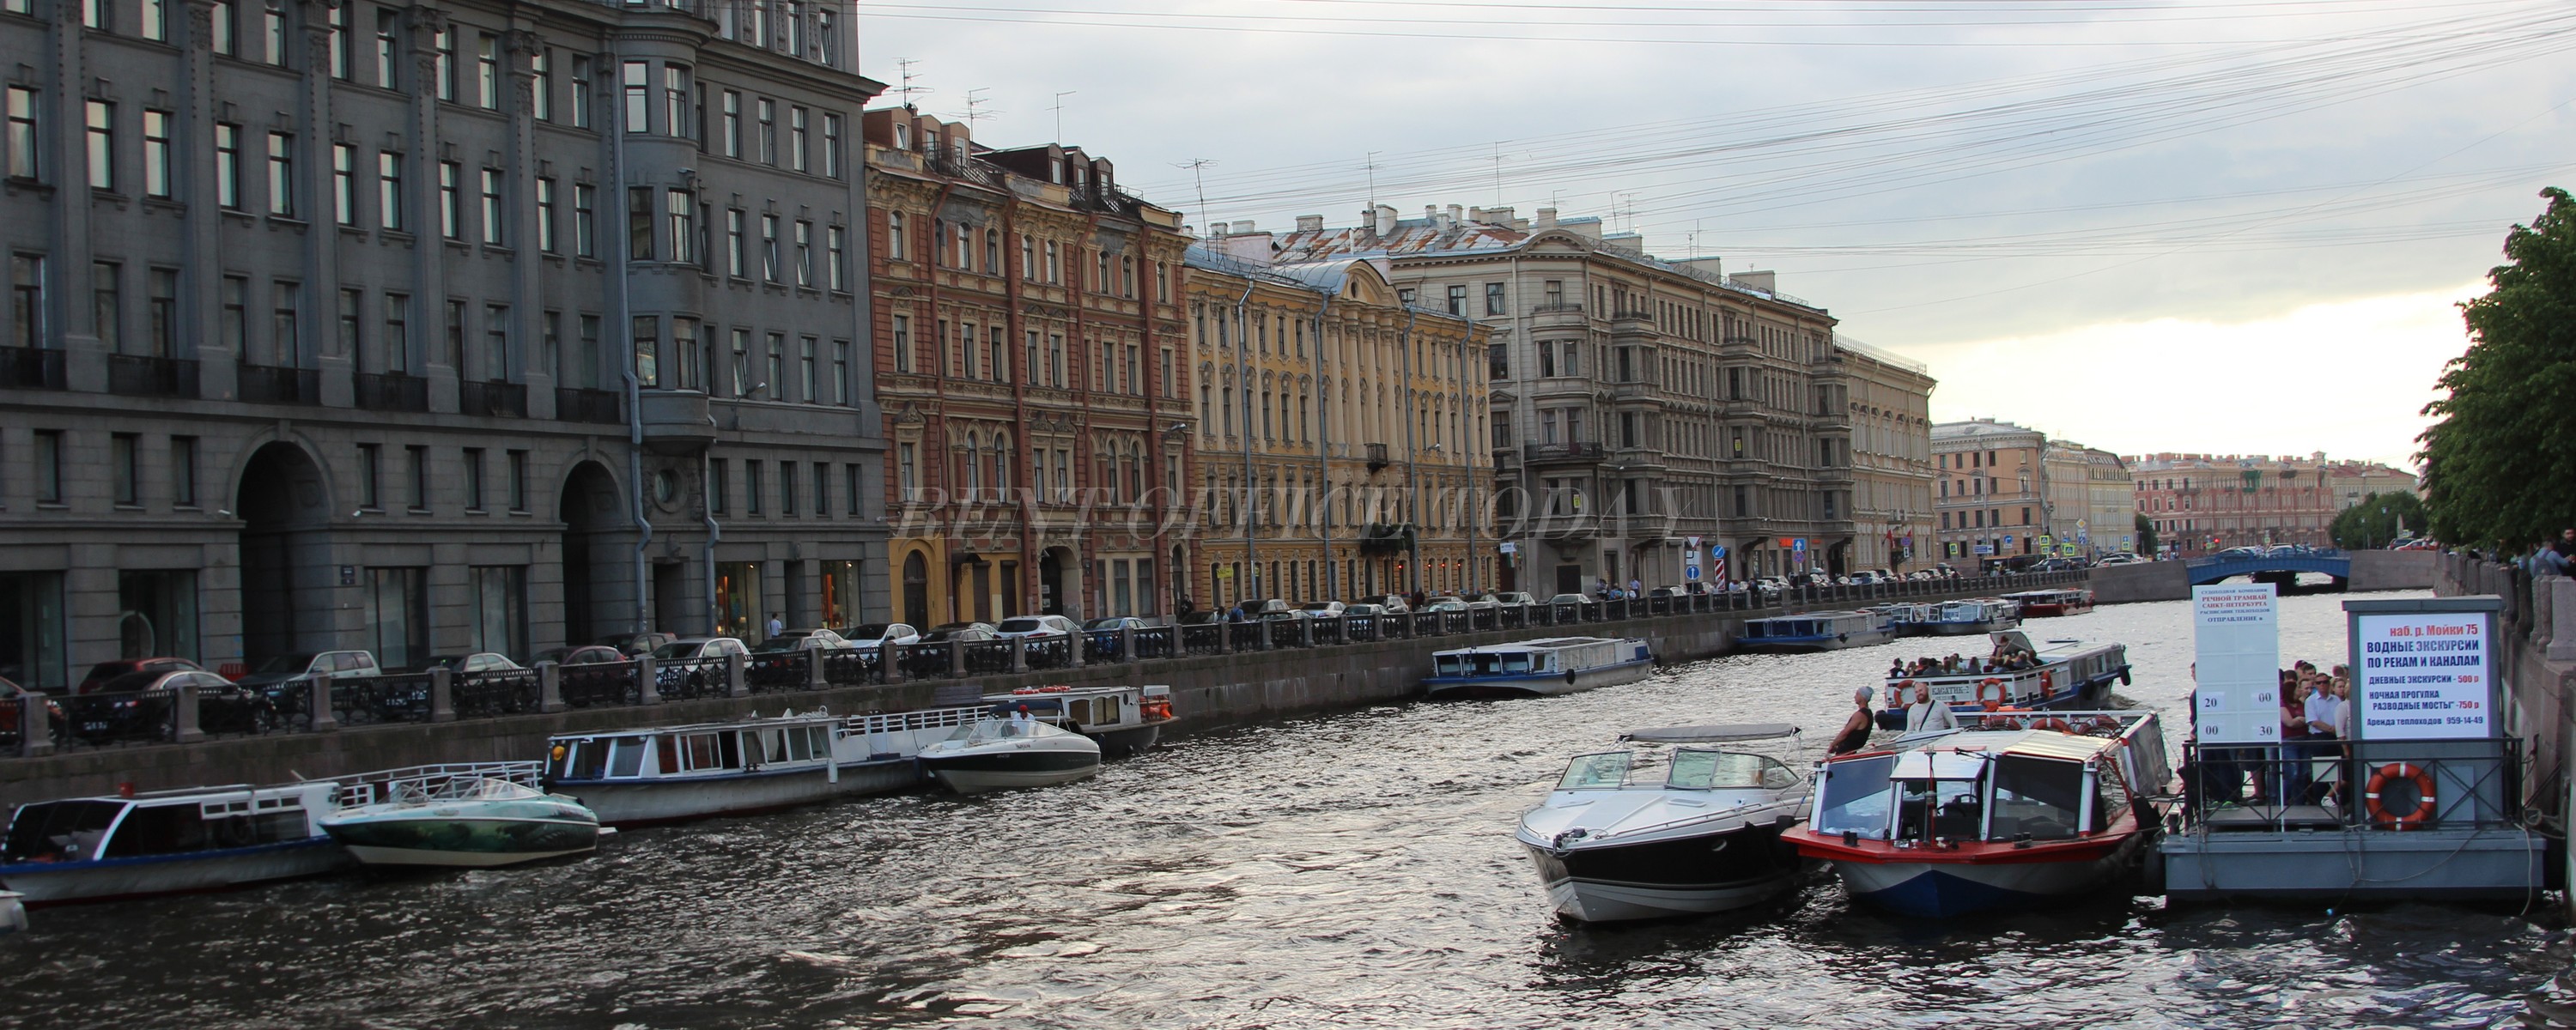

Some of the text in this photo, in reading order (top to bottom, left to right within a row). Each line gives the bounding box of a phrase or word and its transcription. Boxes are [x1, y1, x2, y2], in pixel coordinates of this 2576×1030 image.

[2390, 624, 2478, 637] наб. р. Мойки 75
[2366, 639, 2479, 654] ВОДНЫЕ ЭКСКУРСИИ
[2367, 655, 2480, 668] ПО РЕКАМ И КАНАЛАМ
[2368, 676, 2406, 685] ДНЕВНЫЕ
[2407, 675, 2451, 684] ЭКСКУРСИИ
[2458, 675, 2472, 683] 500
[1931, 686, 1970, 695] КАСАТИК-2
[2369, 690, 2439, 700] НОЧНАЯ ПРОГУЛКА
[2204, 692, 2271, 707] 20 00
[2372, 701, 2421, 711] РАЗВОДНЫЕ
[2366, 718, 2395, 726] Аренда
[2445, 716, 2483, 724] 959-14-49
[2205, 725, 2273, 736] 00 30
